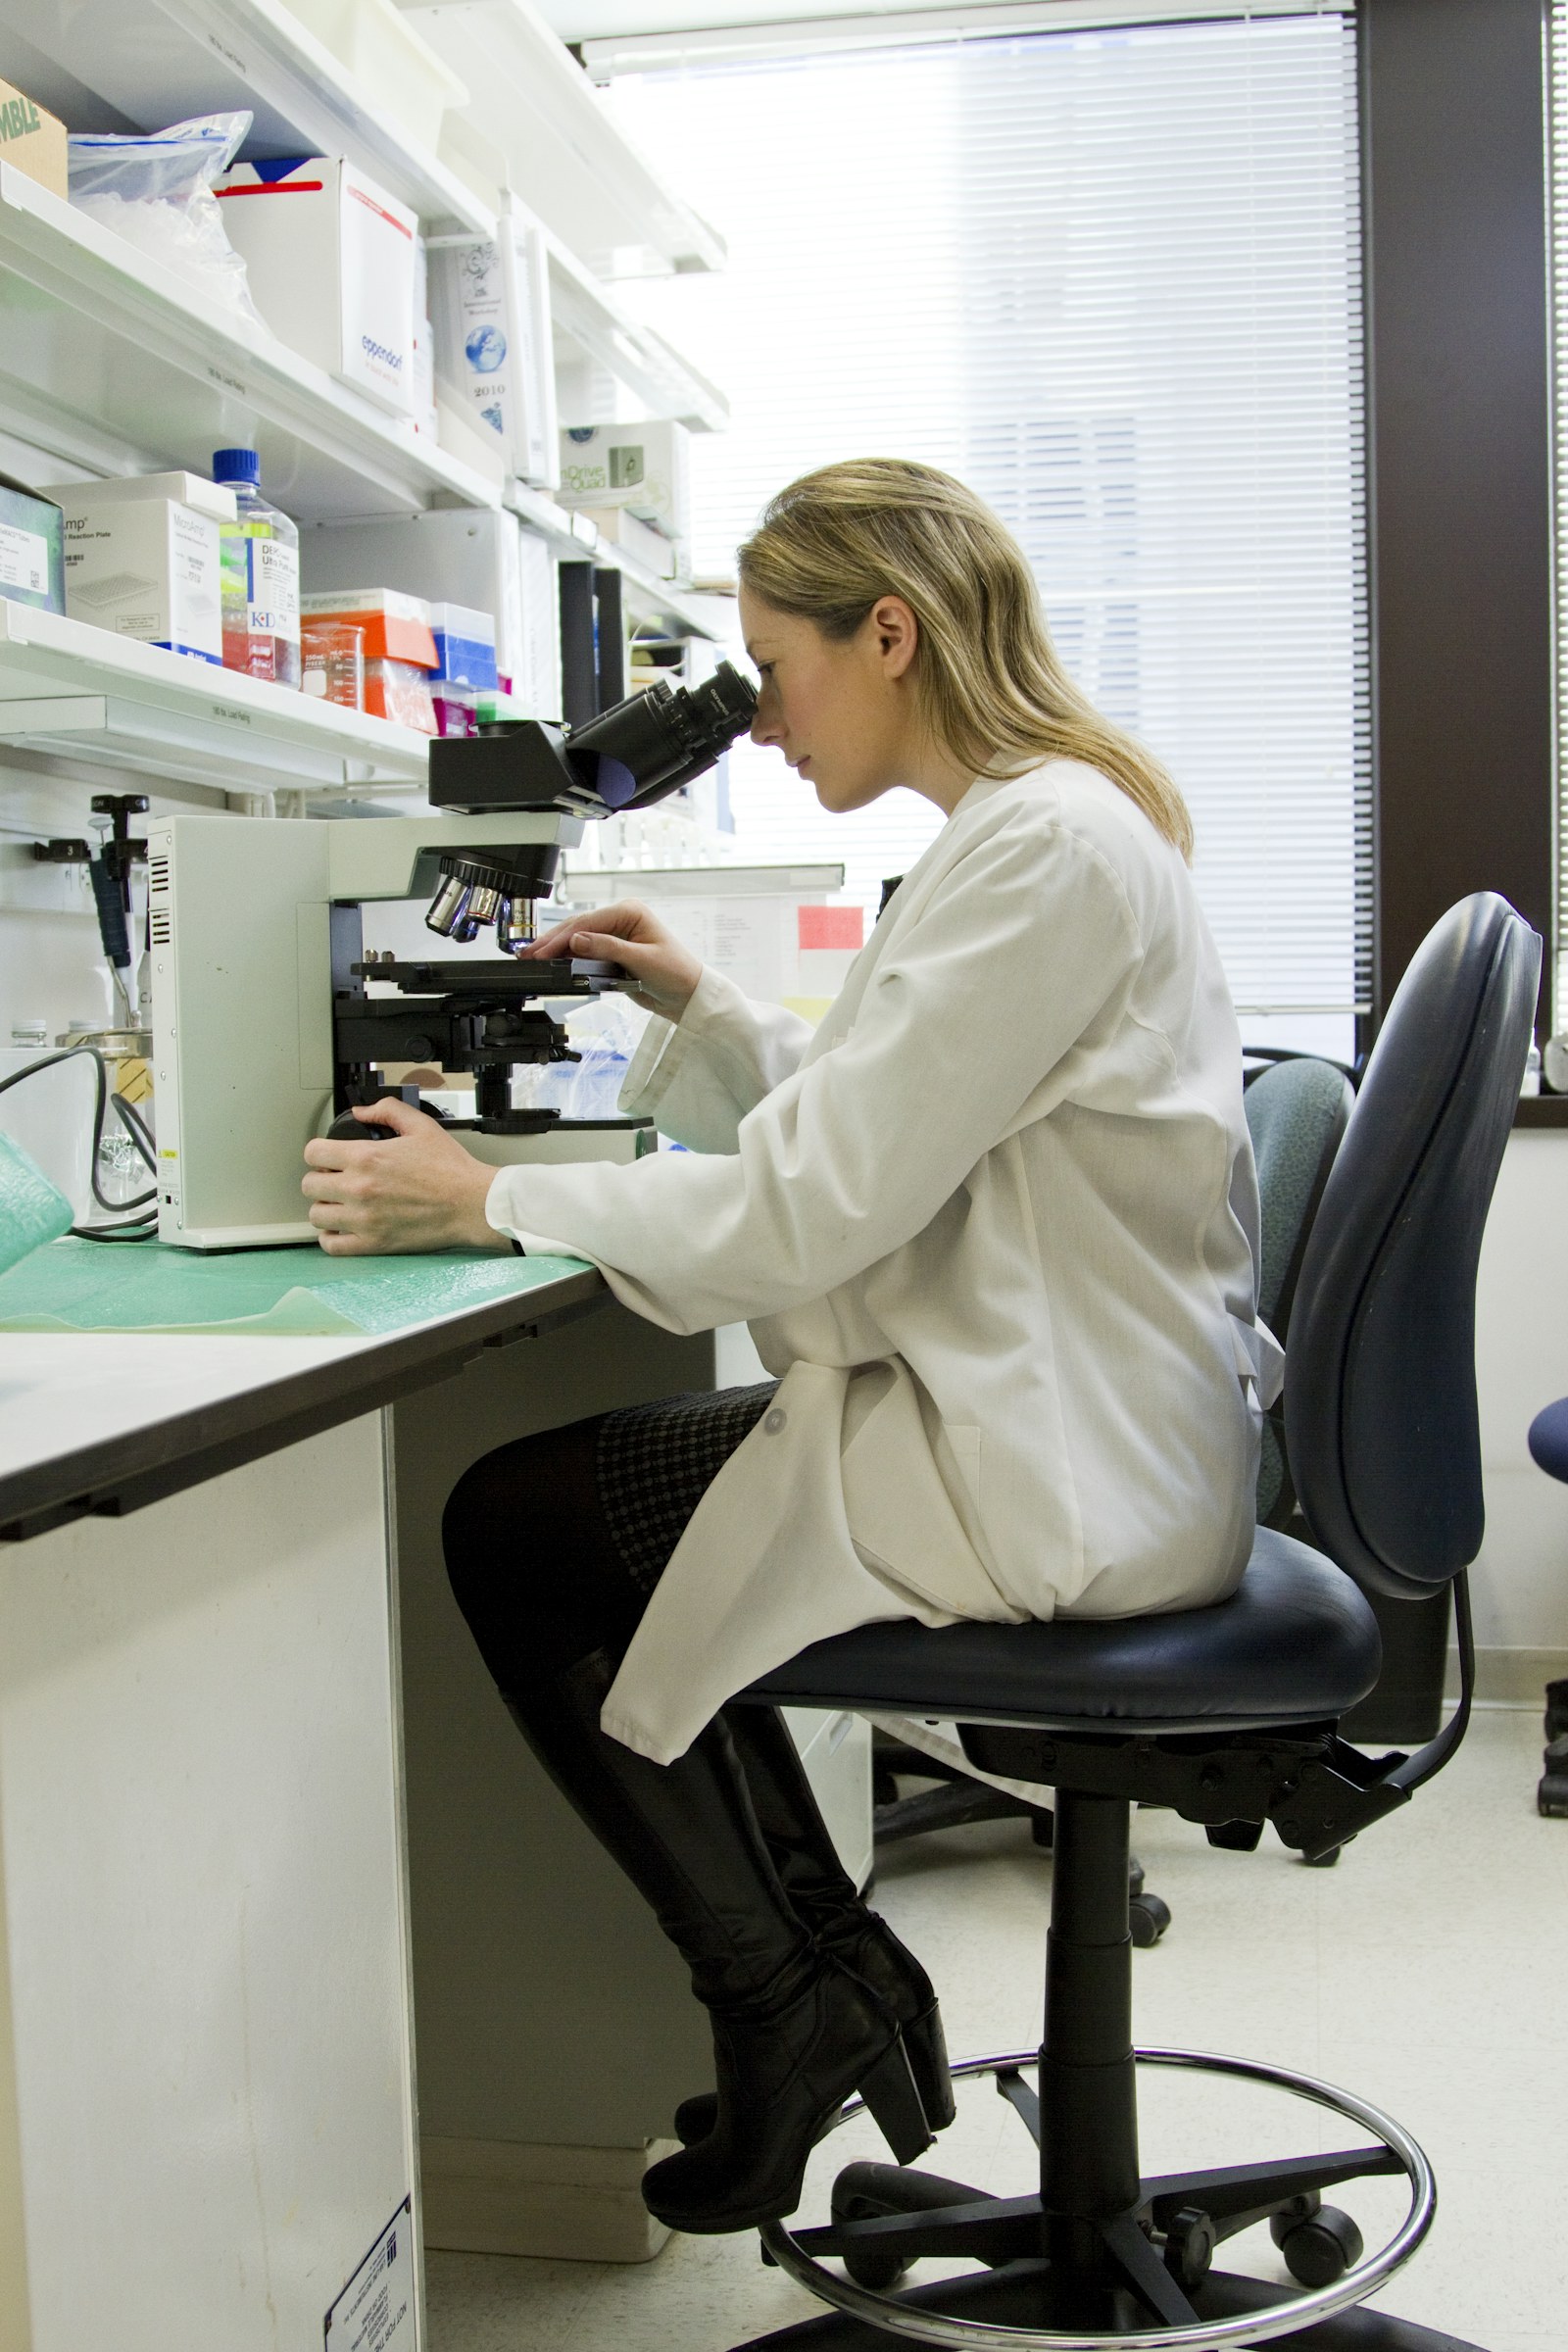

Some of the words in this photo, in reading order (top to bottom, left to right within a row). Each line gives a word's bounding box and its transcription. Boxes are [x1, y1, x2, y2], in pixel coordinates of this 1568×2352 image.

[362, 335, 403, 371] eppendorf
[474, 384, 505, 397] 2010
[570, 474, 606, 494] Quad
[710, 689, 729, 716] OLYMPUS
[67, 846, 74, 856] 3
[378, 2282, 387, 2304] FOOD
[362, 2305, 371, 2327] DRINK
[397, 2300, 407, 2326] NOT
[385, 2317, 395, 2343] FOR
